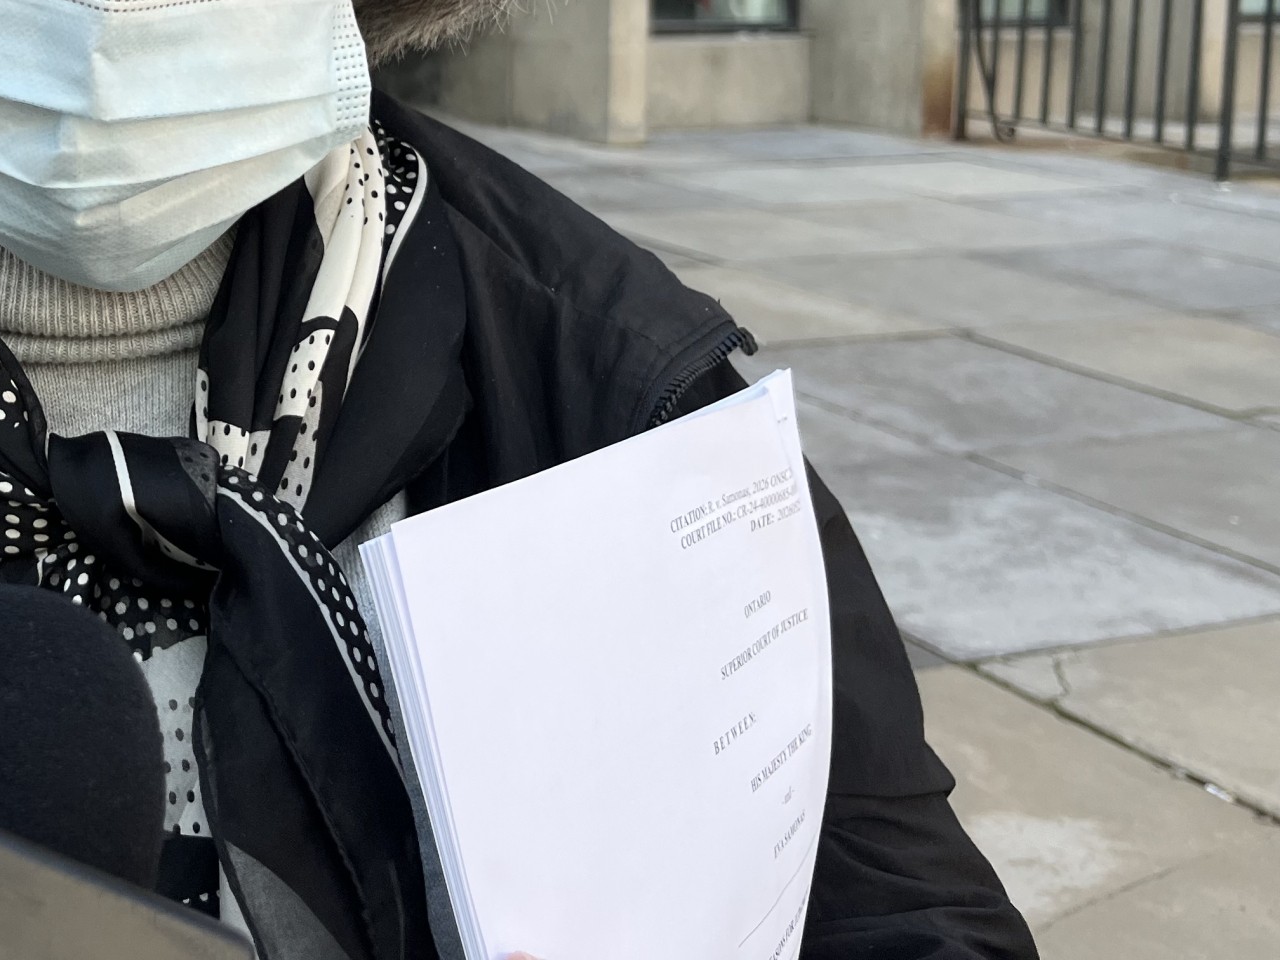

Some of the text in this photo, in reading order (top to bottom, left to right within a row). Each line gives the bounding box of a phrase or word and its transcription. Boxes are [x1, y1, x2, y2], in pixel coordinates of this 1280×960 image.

[670, 504, 708, 533] CITATION:
[681, 525, 706, 549] COURT
[706, 516, 722, 536] FILE
[750, 512, 775, 532] DATE:
[743, 590, 771, 619] ONTARIO
[720, 647, 753, 681] SUPERIOR
[752, 630, 771, 656] COURT
[780, 607, 808, 634] JUSTICE
